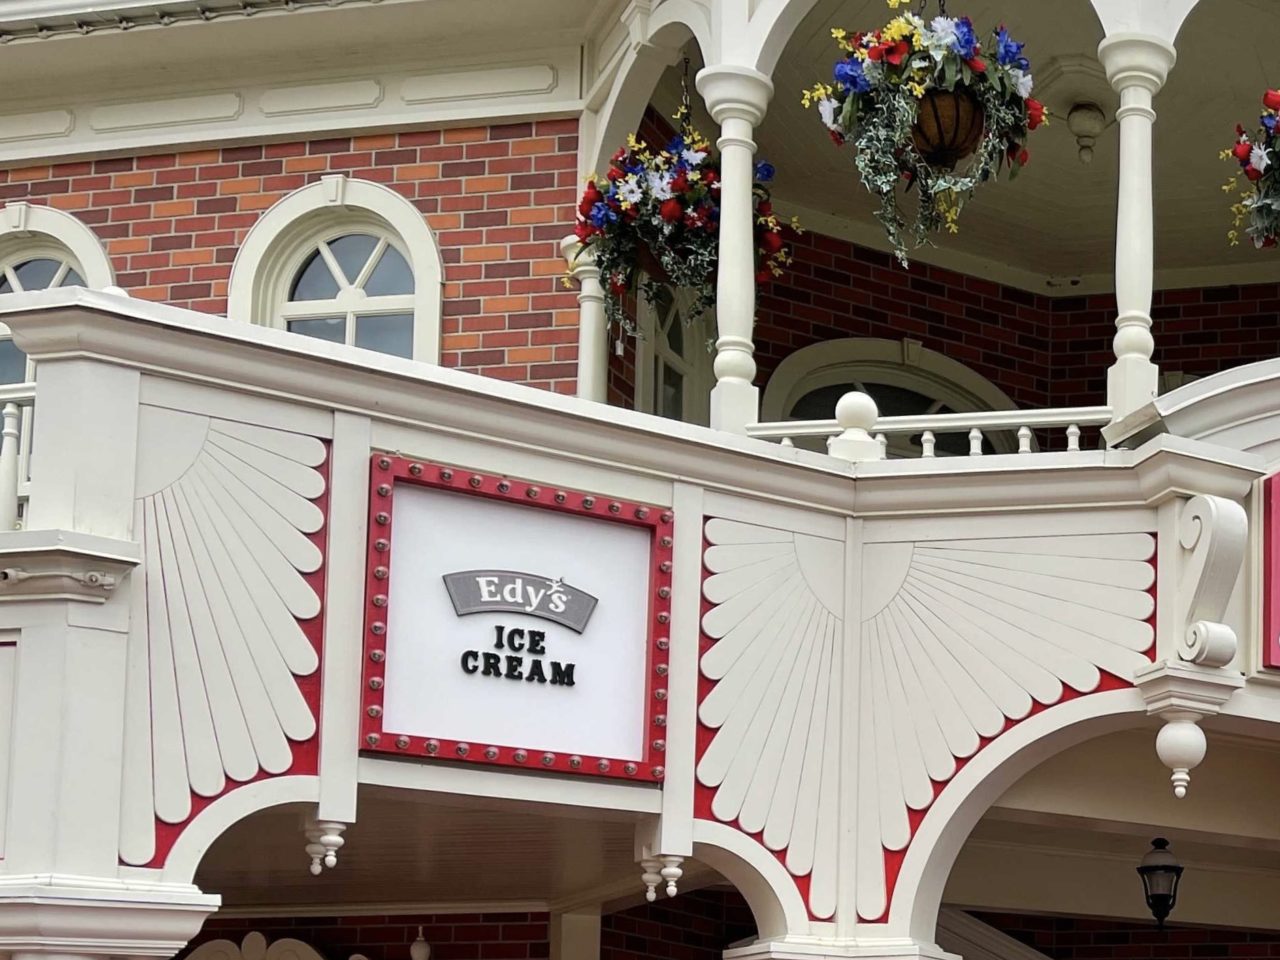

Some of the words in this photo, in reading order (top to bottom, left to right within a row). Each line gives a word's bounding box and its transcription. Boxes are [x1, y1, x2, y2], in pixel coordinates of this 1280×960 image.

[475, 576, 569, 612] Edy's
[494, 625, 546, 655] ICE
[460, 650, 576, 687] CREAM
